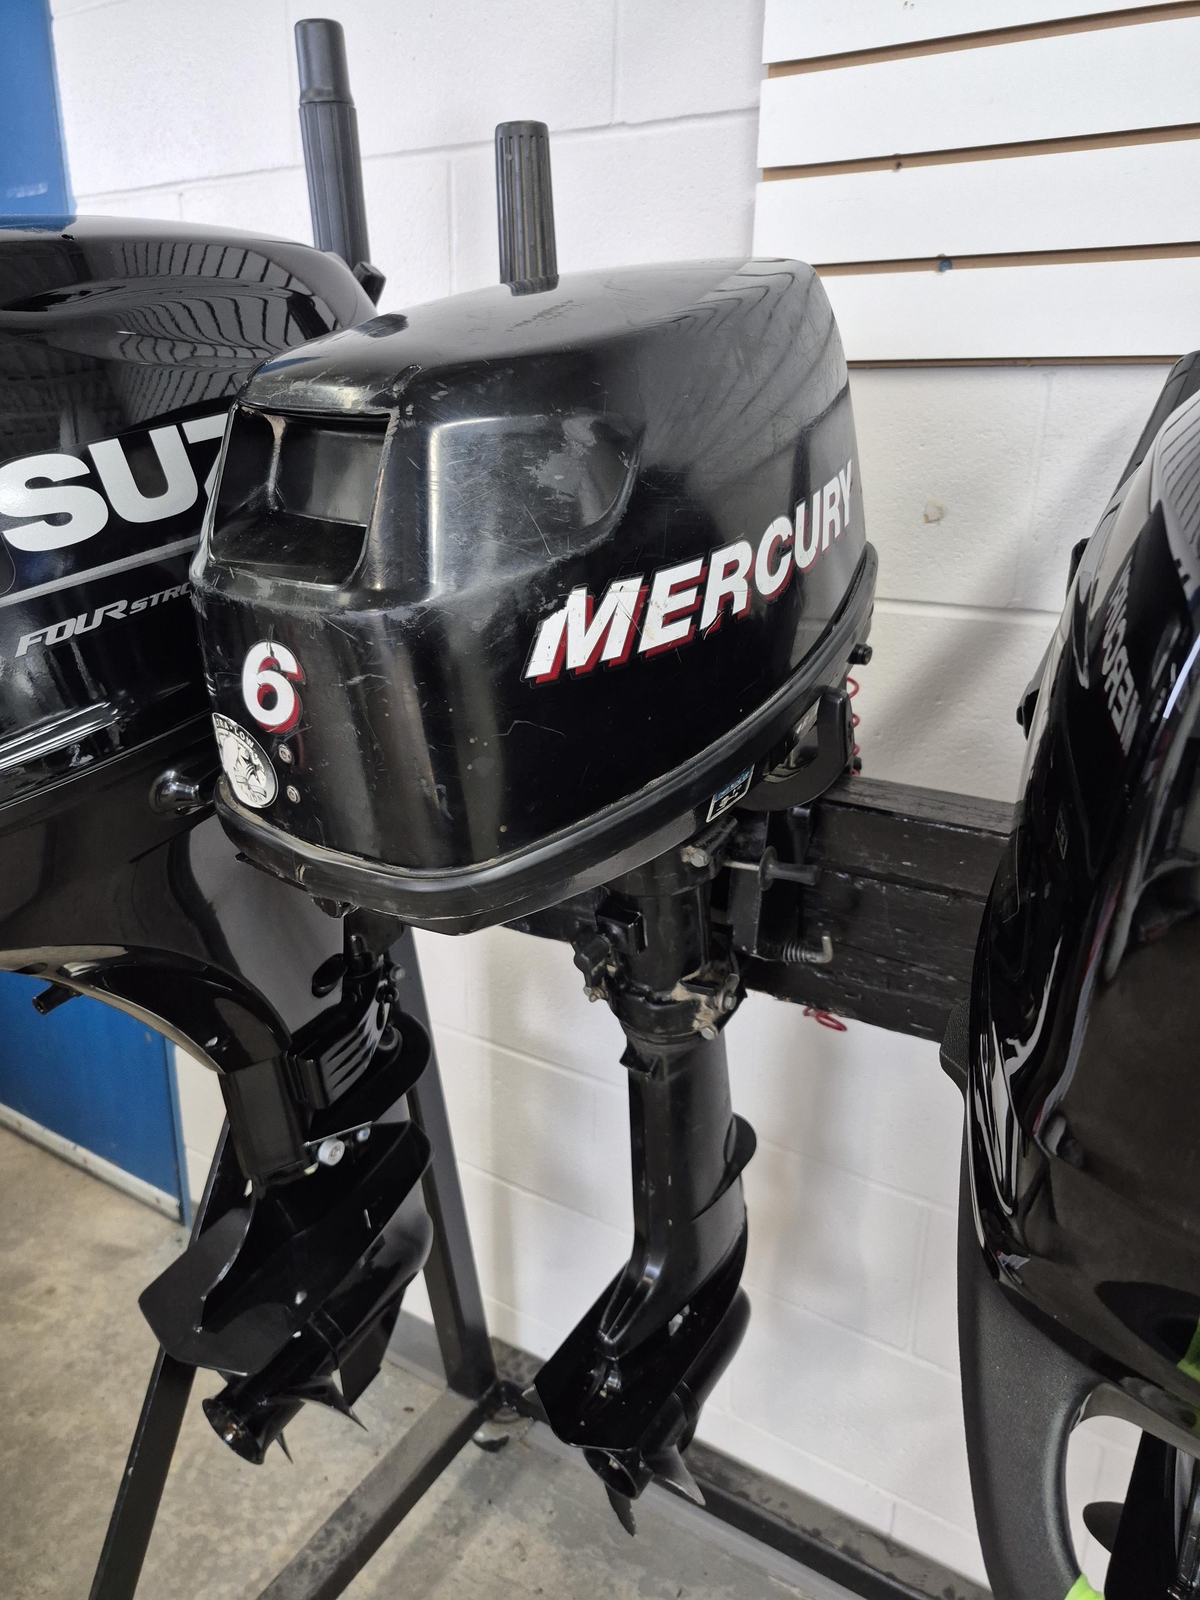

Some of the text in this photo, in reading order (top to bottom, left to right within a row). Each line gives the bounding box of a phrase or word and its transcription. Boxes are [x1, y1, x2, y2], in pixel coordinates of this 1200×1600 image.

[524, 459, 854, 683] MERCURY
[15, 600, 128, 658] FOUR
[242, 641, 304, 733] 6
